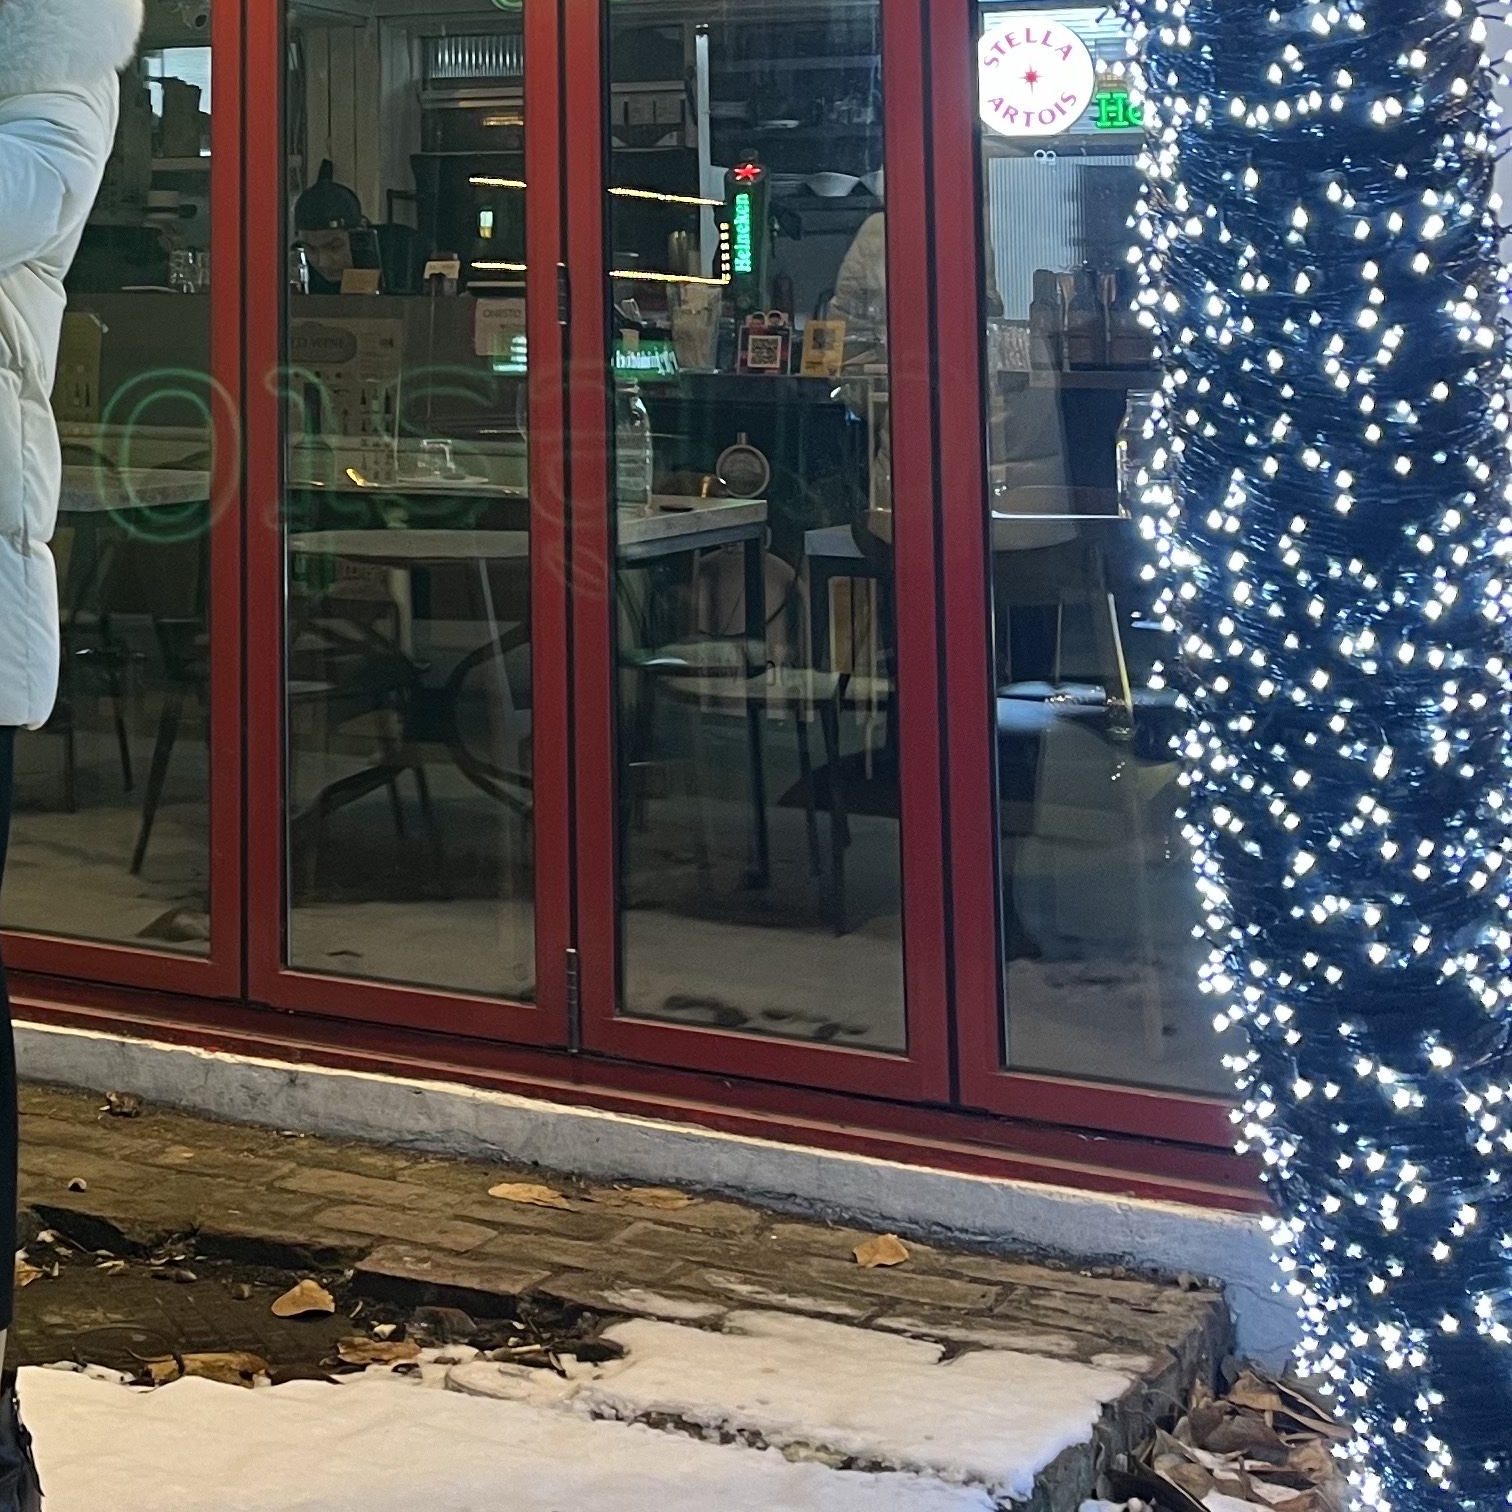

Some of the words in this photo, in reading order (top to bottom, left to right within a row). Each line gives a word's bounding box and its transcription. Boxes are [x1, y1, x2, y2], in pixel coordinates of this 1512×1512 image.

[984, 27, 1073, 68] STELLA
[987, 91, 1077, 128] ARTOIS
[734, 193, 753, 273] Heineken
